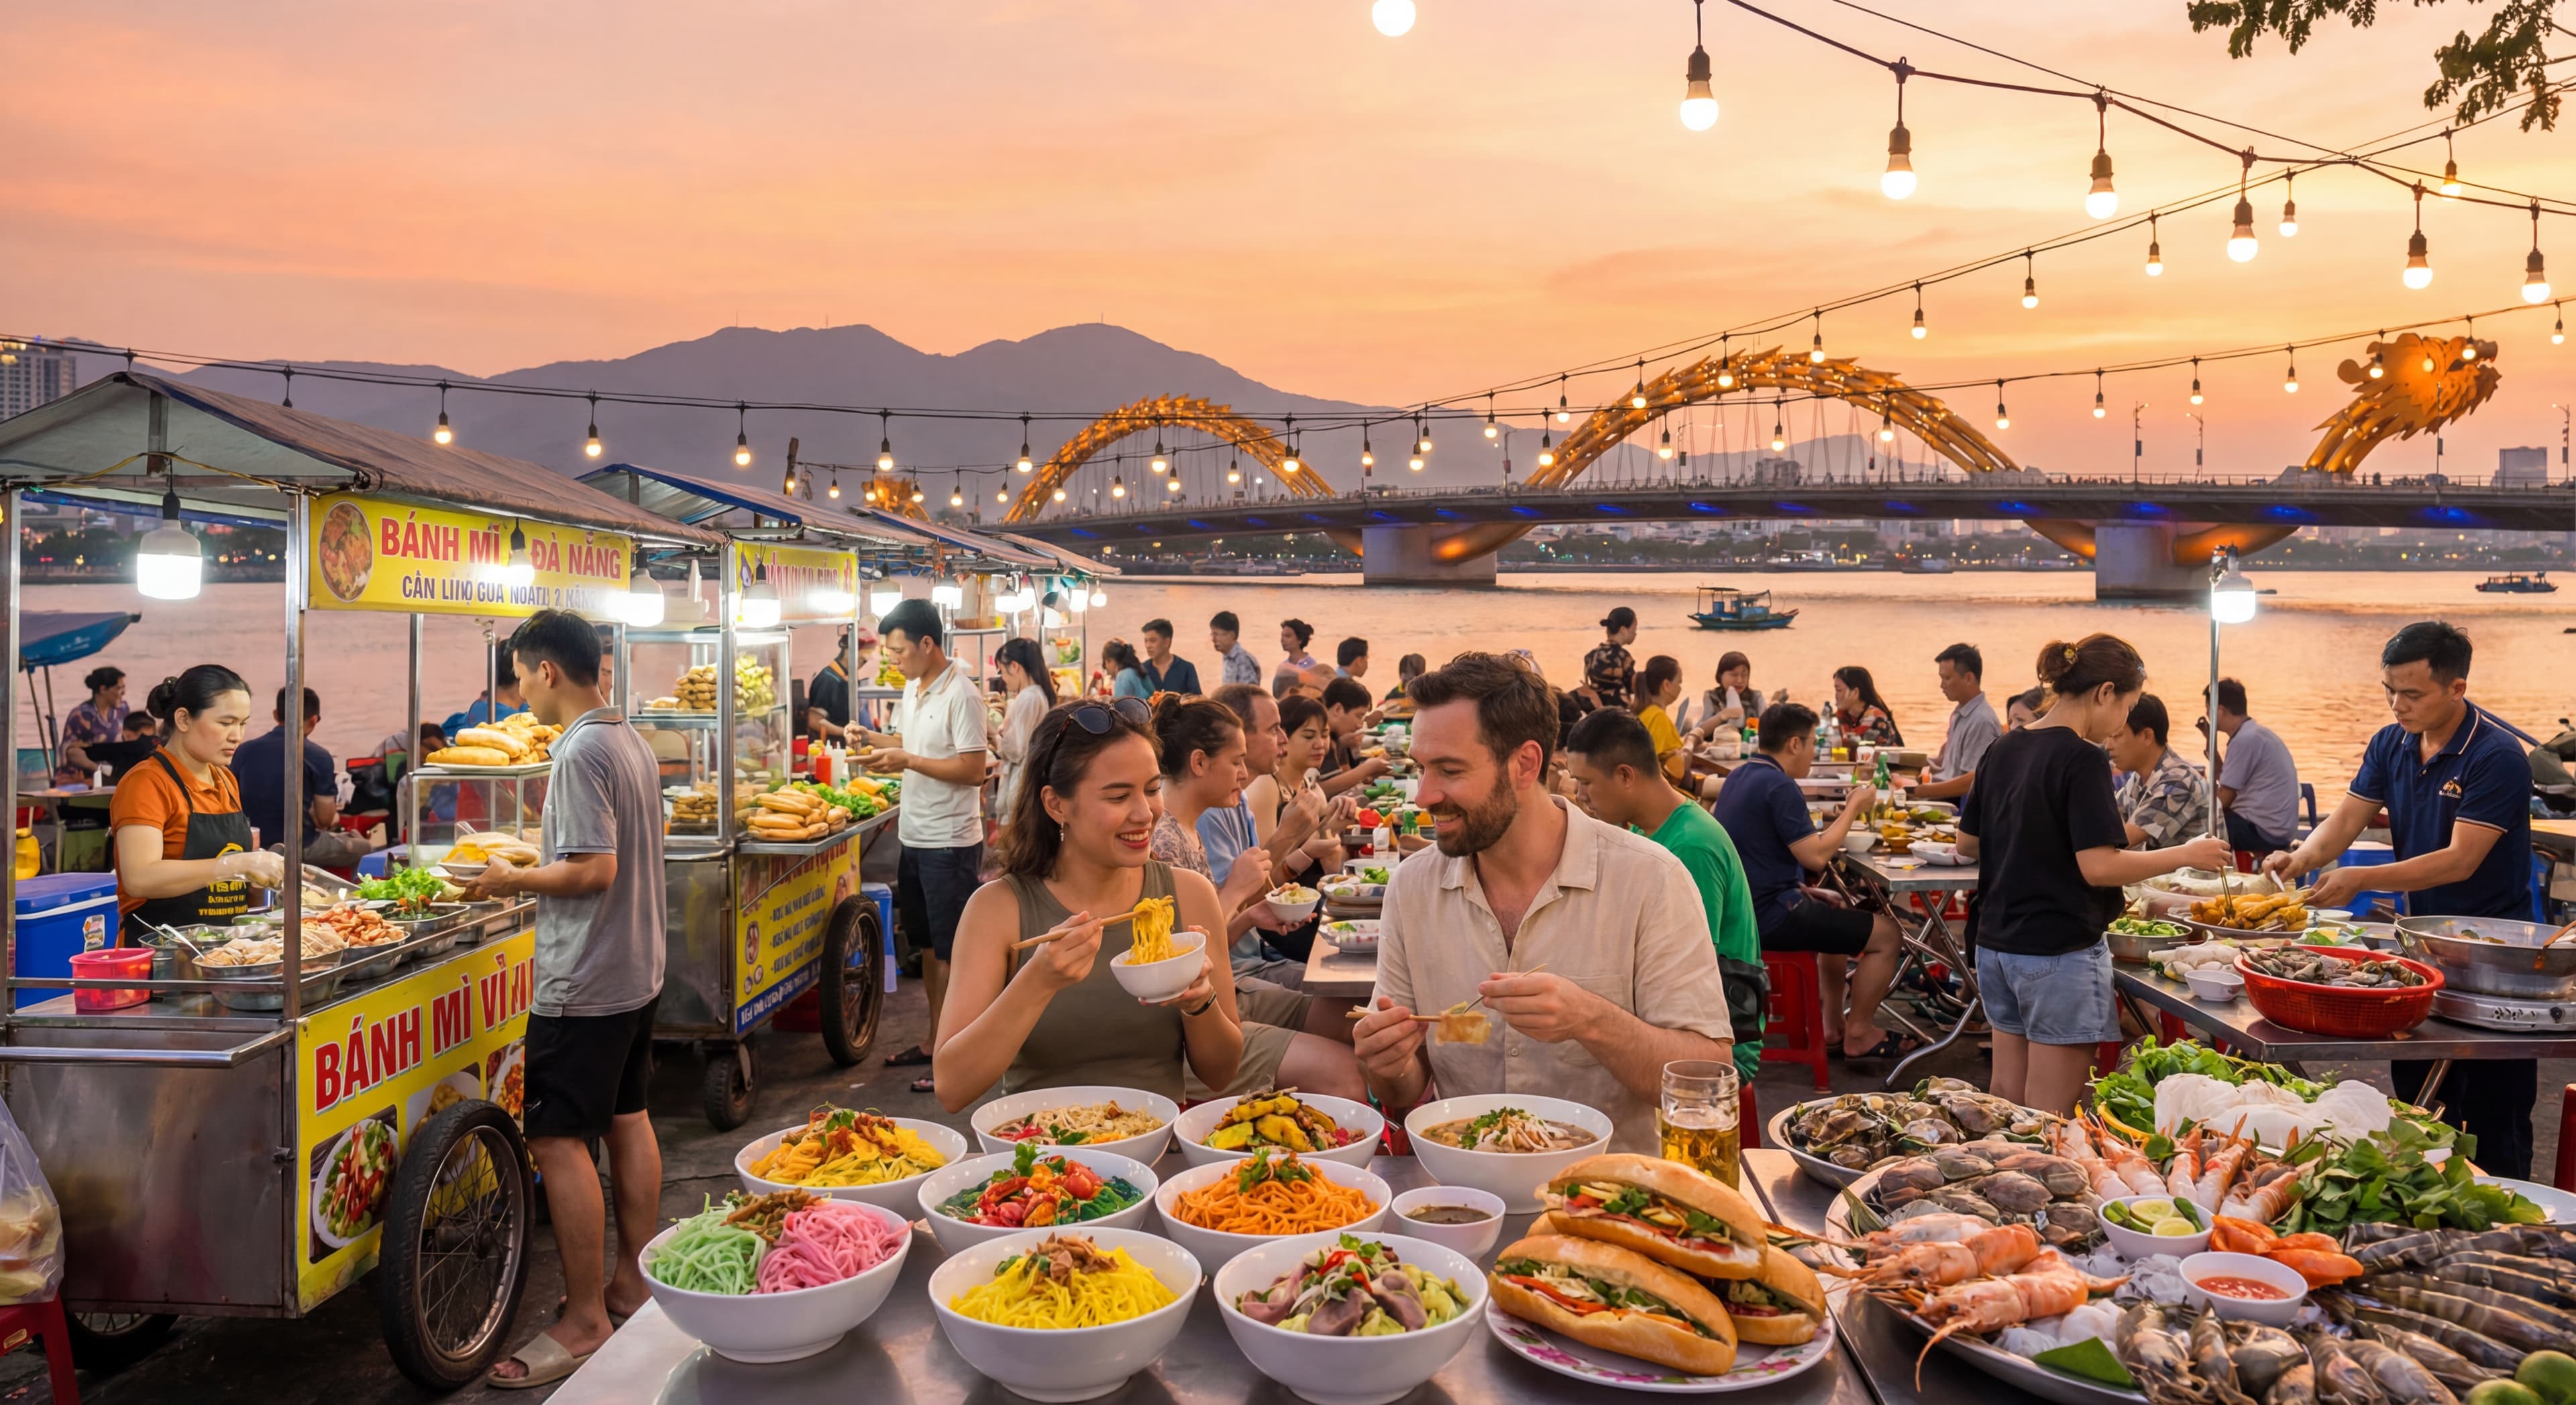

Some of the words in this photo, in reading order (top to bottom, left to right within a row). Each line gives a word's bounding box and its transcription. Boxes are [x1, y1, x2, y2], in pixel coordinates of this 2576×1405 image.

[381, 510, 460, 562] BÁNH
[531, 531, 561, 573] ĐÀ
[315, 1005, 423, 1113] BÁNH
[432, 974, 472, 1056] MÌ
